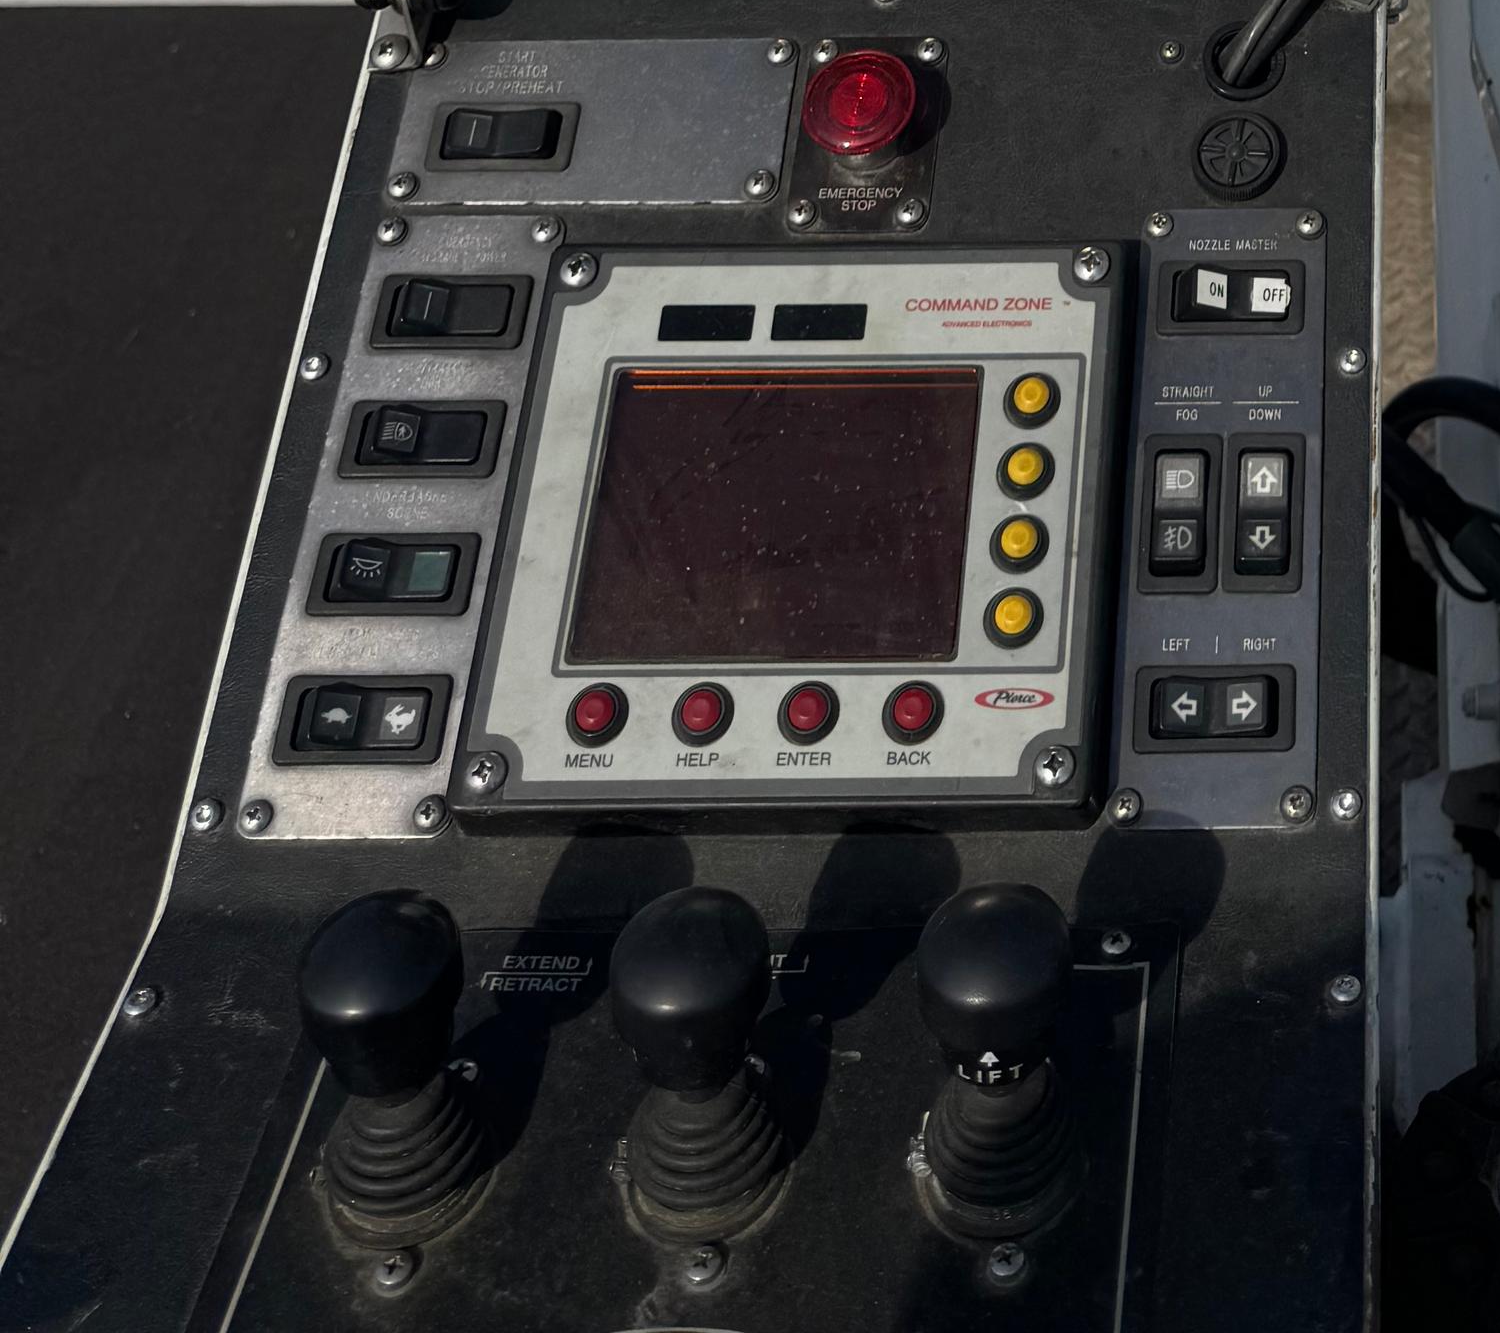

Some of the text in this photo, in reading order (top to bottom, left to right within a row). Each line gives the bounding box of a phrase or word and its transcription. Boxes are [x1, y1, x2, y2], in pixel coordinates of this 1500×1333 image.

[818, 188, 903, 199] EMERGENCY
[841, 200, 877, 211] STOP
[1189, 240, 1277, 250] NOZZLE MASTER
[1210, 282, 1224, 297] ON
[1263, 288, 1286, 301] OFF
[905, 298, 1052, 311] COMMAND ZONE
[1162, 386, 1214, 397] STRAIGHT
[1258, 385, 1272, 397] UP
[1176, 409, 1198, 420] FOG
[1249, 409, 1281, 420] DOWN
[1162, 638, 1190, 651] LEFT
[1243, 638, 1276, 651] RIGHT
[995, 689, 1037, 705] Pierce
[564, 754, 614, 768] MENU
[675, 753, 719, 767] HELP
[776, 752, 831, 766] ENTER
[886, 751, 931, 766] BACK
[502, 955, 580, 970] EXTEND
[489, 977, 581, 992] RETRACT
[958, 1063, 1023, 1085] LIFT
